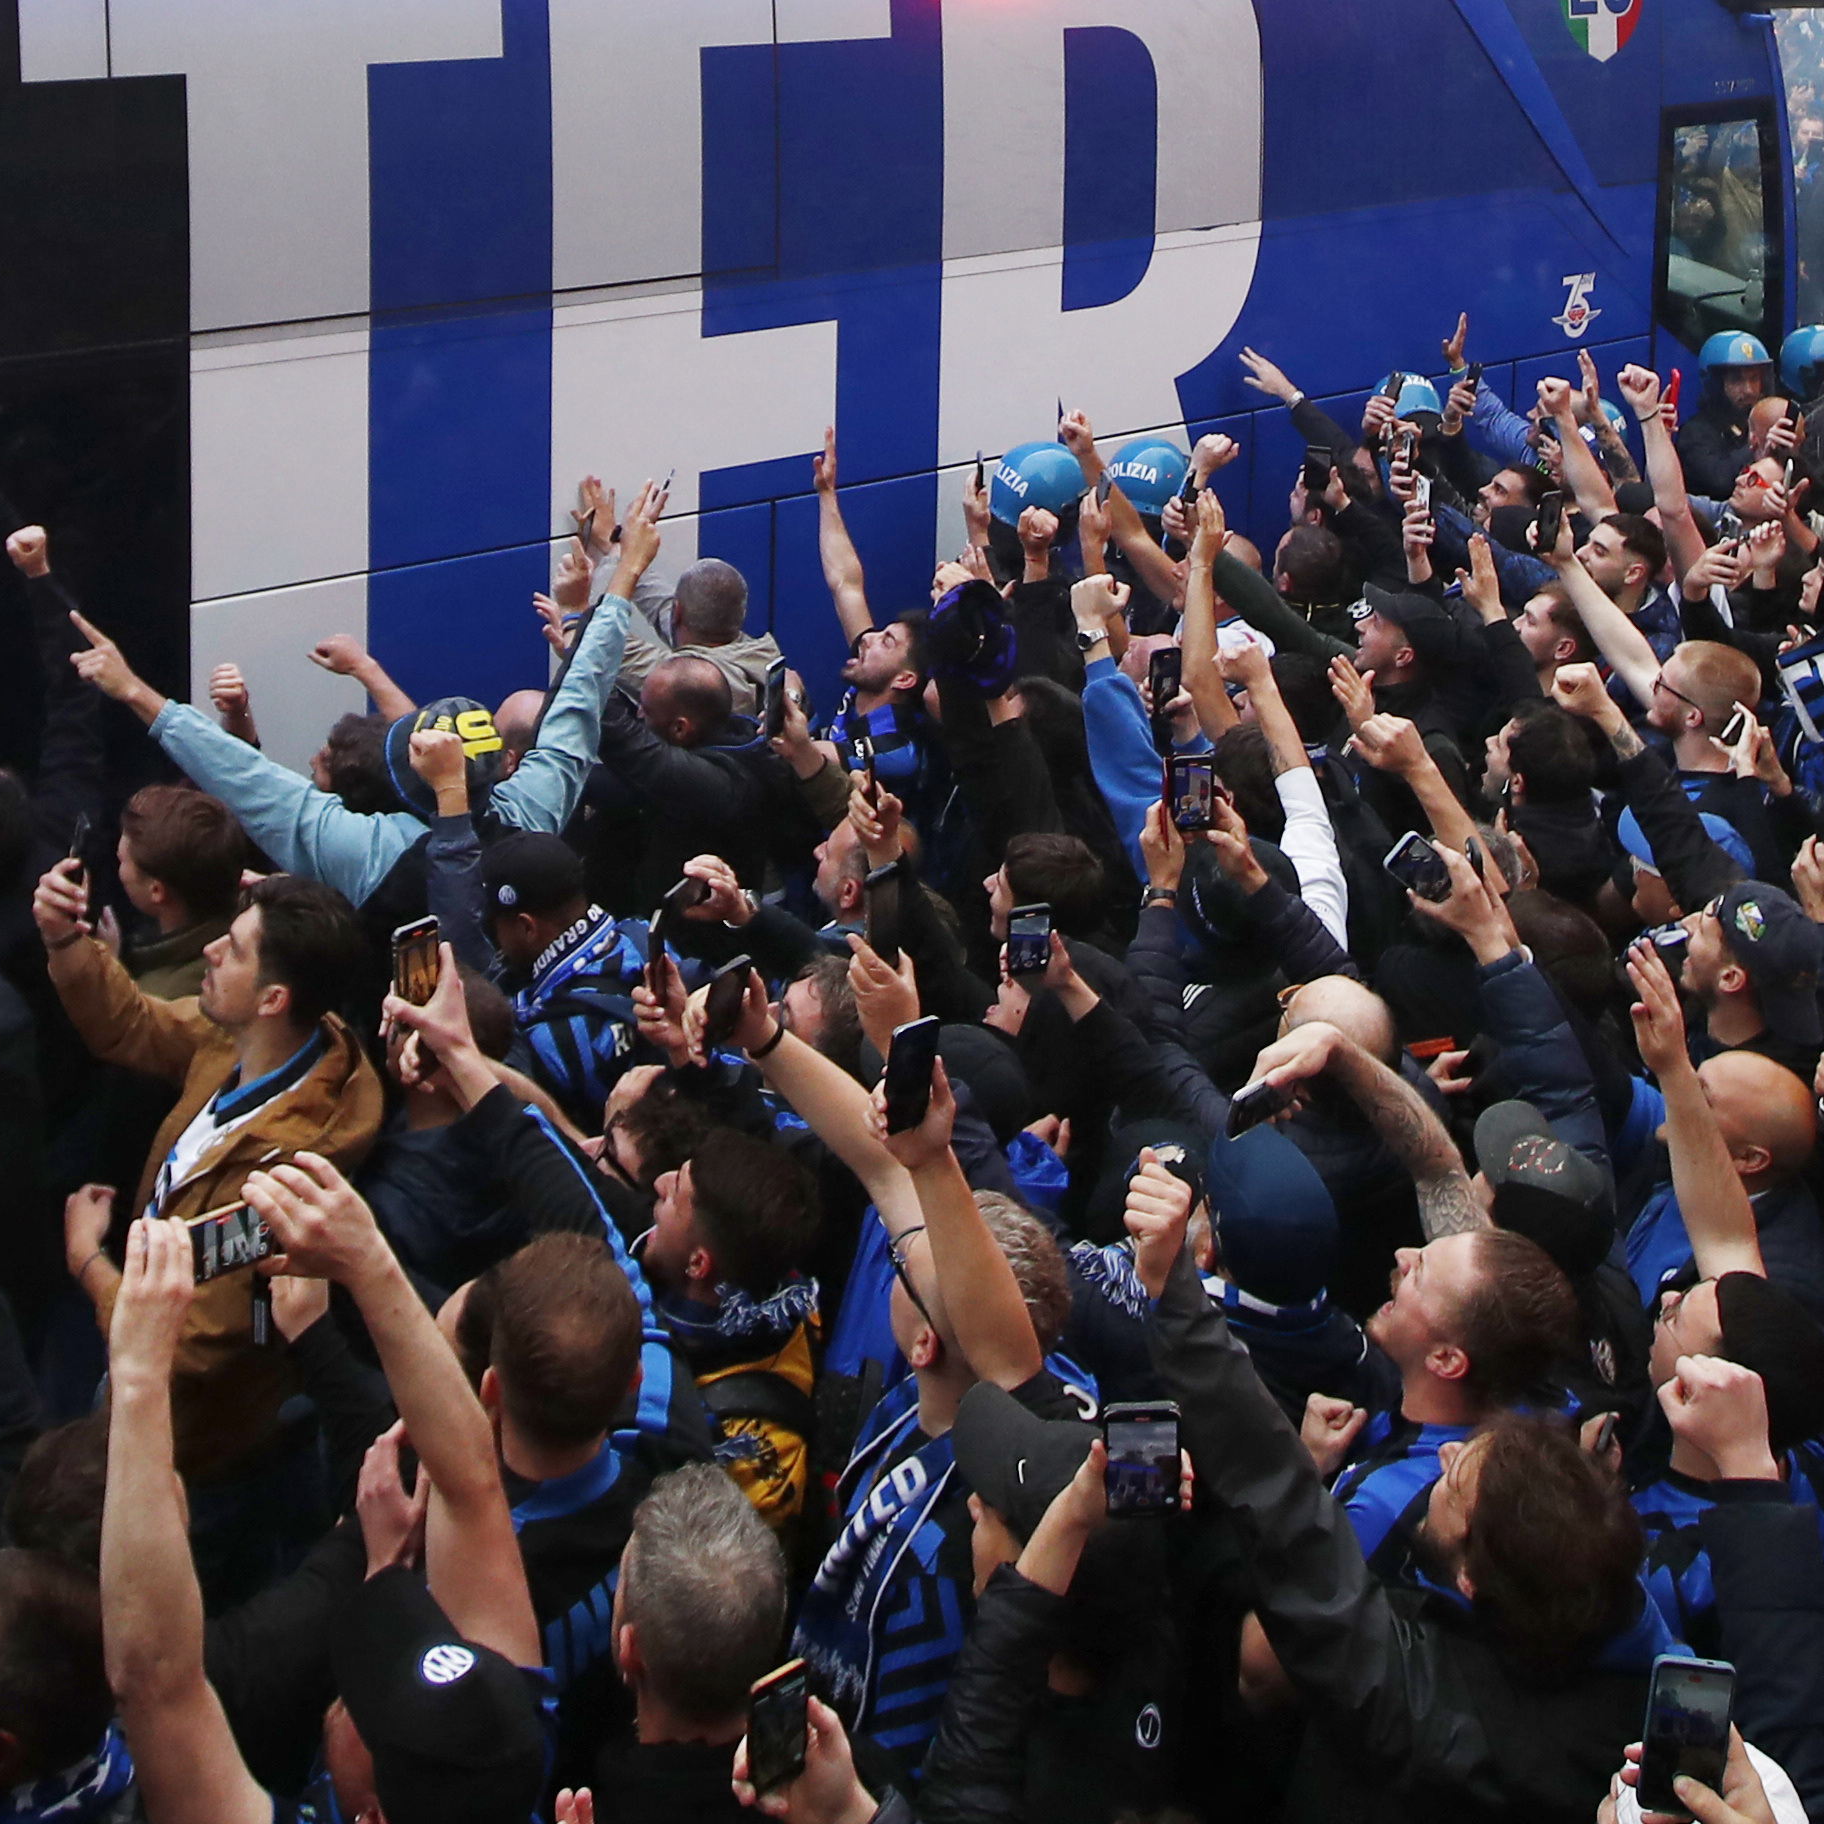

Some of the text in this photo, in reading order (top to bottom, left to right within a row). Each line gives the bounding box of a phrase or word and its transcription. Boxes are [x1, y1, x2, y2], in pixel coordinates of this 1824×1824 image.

[1562, 272, 1596, 339] 75
[994, 463, 1030, 499] LIZIA
[455, 709, 504, 762] 10
